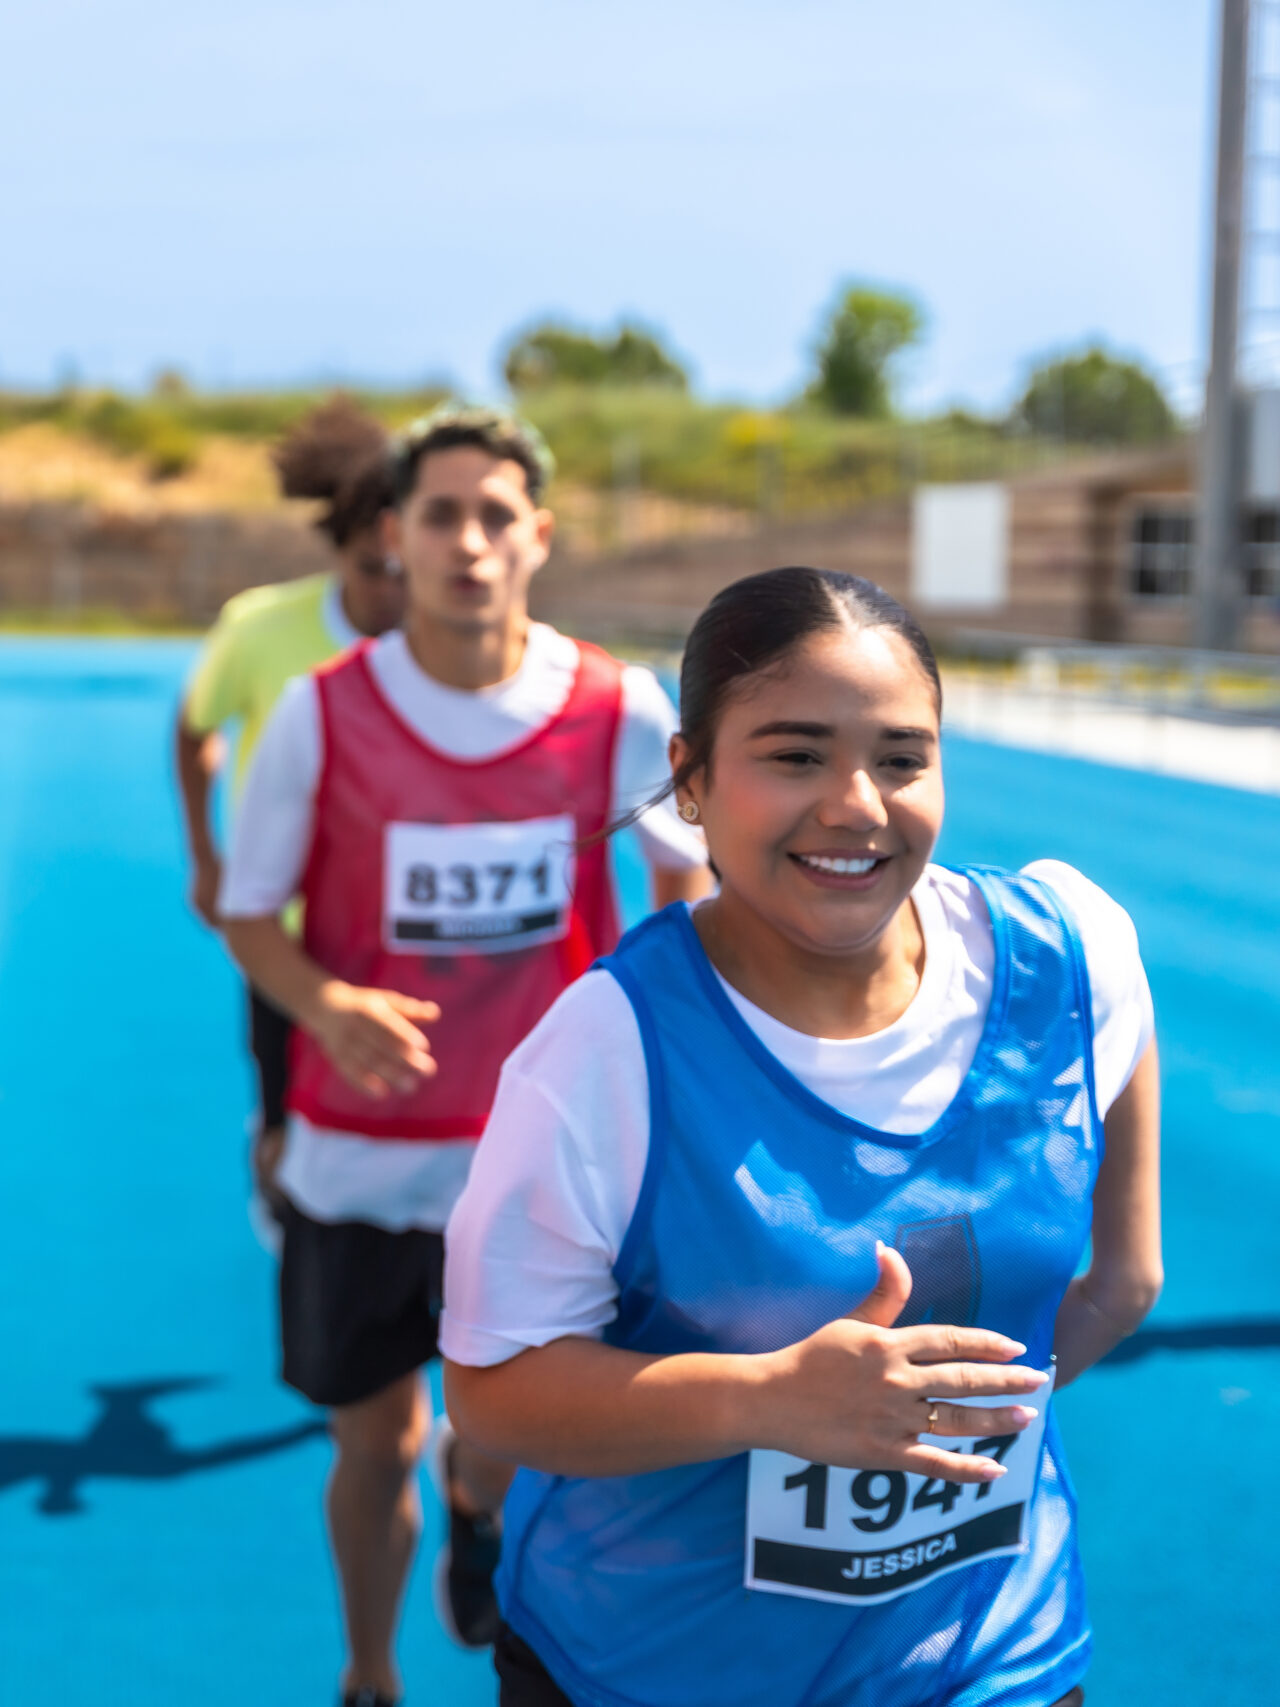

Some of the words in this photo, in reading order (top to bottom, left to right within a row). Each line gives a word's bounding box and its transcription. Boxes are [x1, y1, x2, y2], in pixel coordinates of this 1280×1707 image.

[406, 861, 548, 906] 8371
[783, 1431, 1019, 1533] 1947
[841, 1533, 957, 1579] JESSICA
